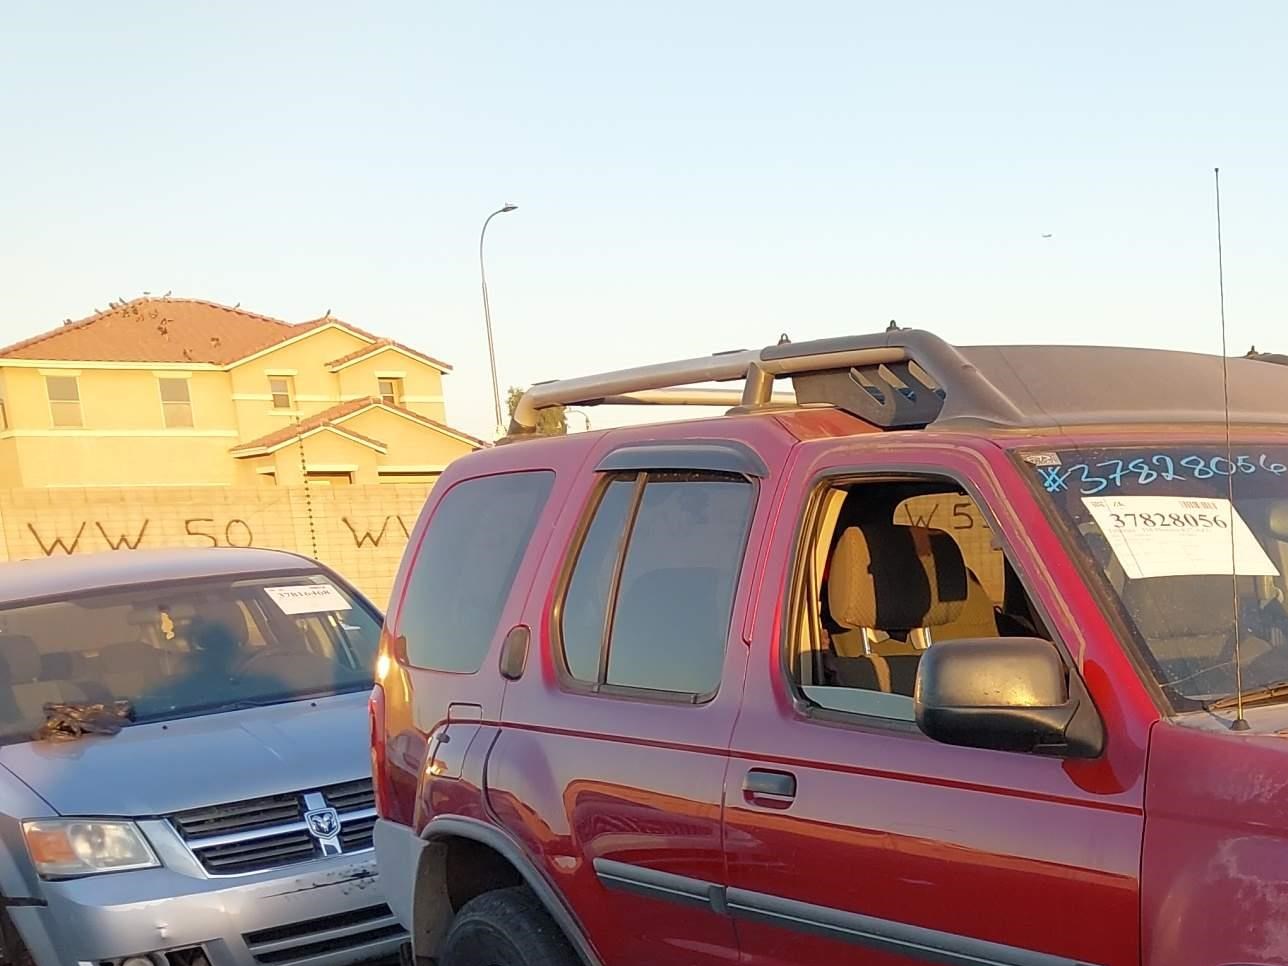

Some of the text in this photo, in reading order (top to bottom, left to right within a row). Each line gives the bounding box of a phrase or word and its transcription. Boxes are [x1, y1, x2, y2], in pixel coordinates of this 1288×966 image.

[953, 502, 991, 530] 5
[1109, 512, 1228, 529] 37828056
[27, 518, 253, 556] WW 50
